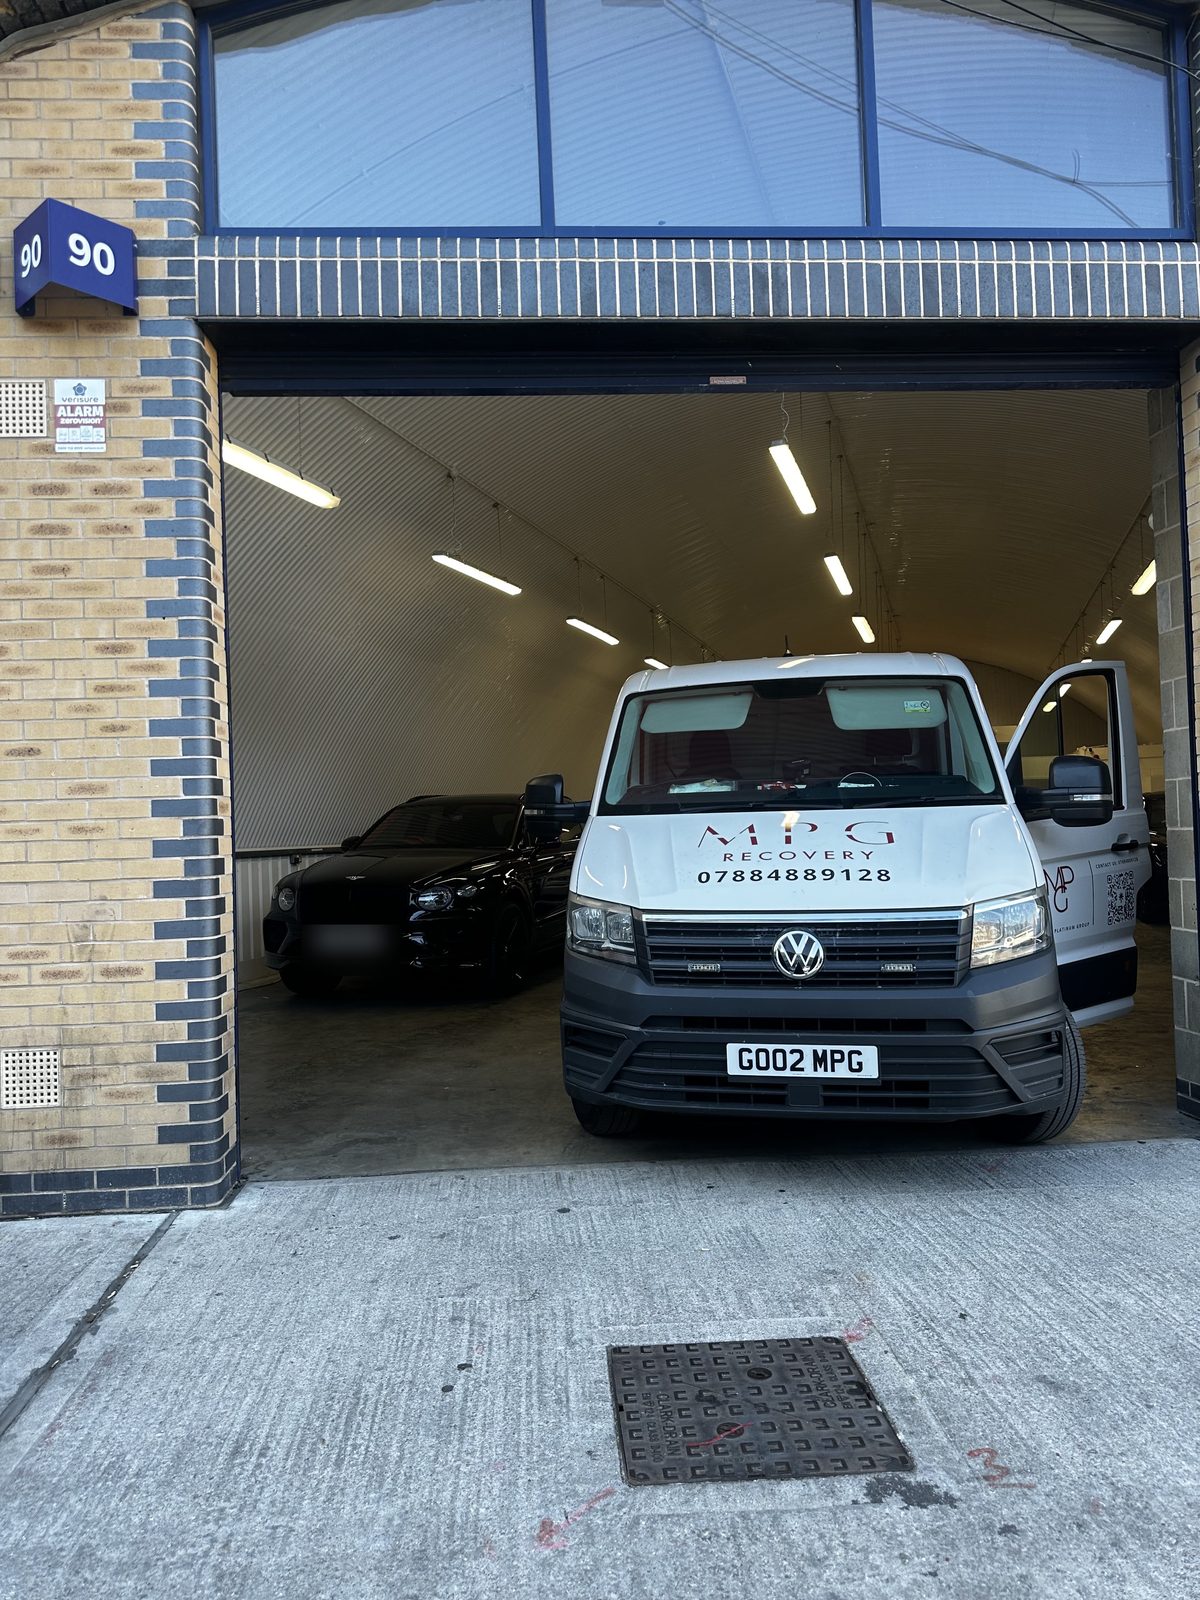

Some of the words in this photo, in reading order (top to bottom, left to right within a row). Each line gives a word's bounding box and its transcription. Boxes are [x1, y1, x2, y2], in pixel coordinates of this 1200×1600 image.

[21, 234, 42, 278] 90
[68, 233, 115, 276] 90
[57, 405, 104, 417] ALARM
[698, 821, 895, 848] MPG
[723, 851, 874, 862] RECOVERY
[697, 868, 891, 884] 07884889128
[812, 1048, 864, 1074] MPG
[656, 1393, 681, 1457] CLARK-DRAIN
